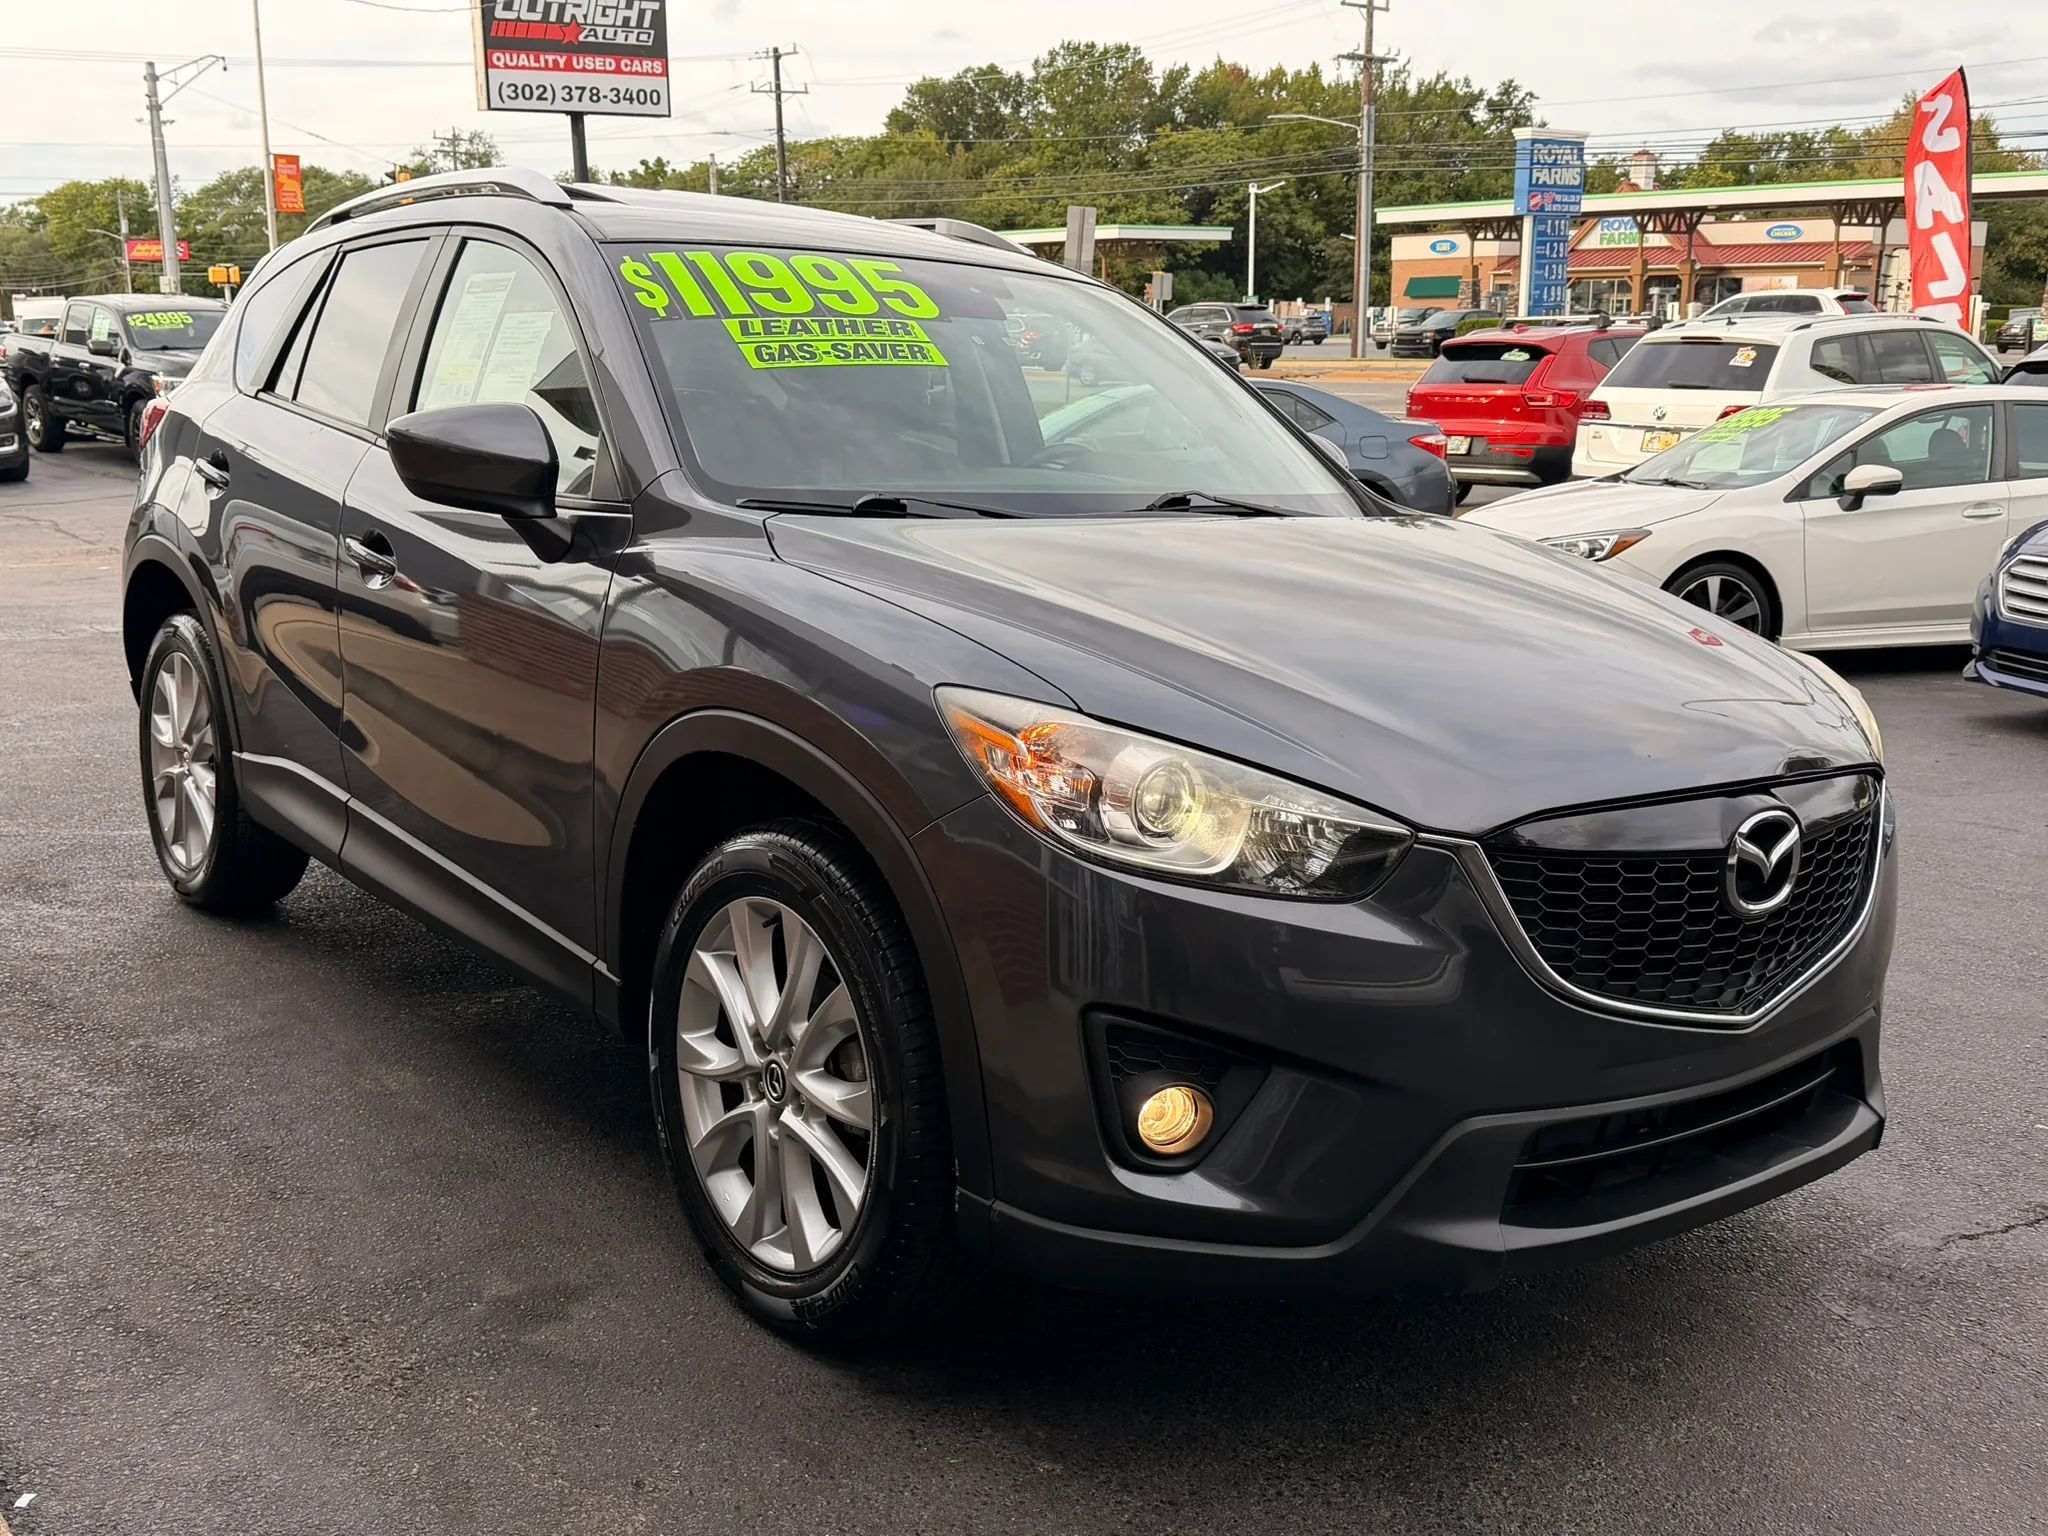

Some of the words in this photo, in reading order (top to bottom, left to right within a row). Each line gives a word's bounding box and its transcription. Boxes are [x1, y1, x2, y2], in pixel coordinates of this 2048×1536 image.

[493, 0, 661, 28] OUTRIGHT
[583, 28, 652, 44] AUTO
[491, 52, 568, 70] QUALITY
[572, 56, 616, 71] USED
[620, 59, 663, 74] CARS
[497, 82, 556, 105] (302)
[561, 86, 661, 106] 378-3400
[1532, 143, 1582, 165] ROYAL
[1531, 166, 1582, 186] FARMS
[1600, 218, 1638, 231] ROYA
[619, 251, 940, 319] $11995
[126, 311, 193, 327] $24995
[738, 318, 917, 338] LEATHER
[754, 342, 934, 364] GAS-SAVER
